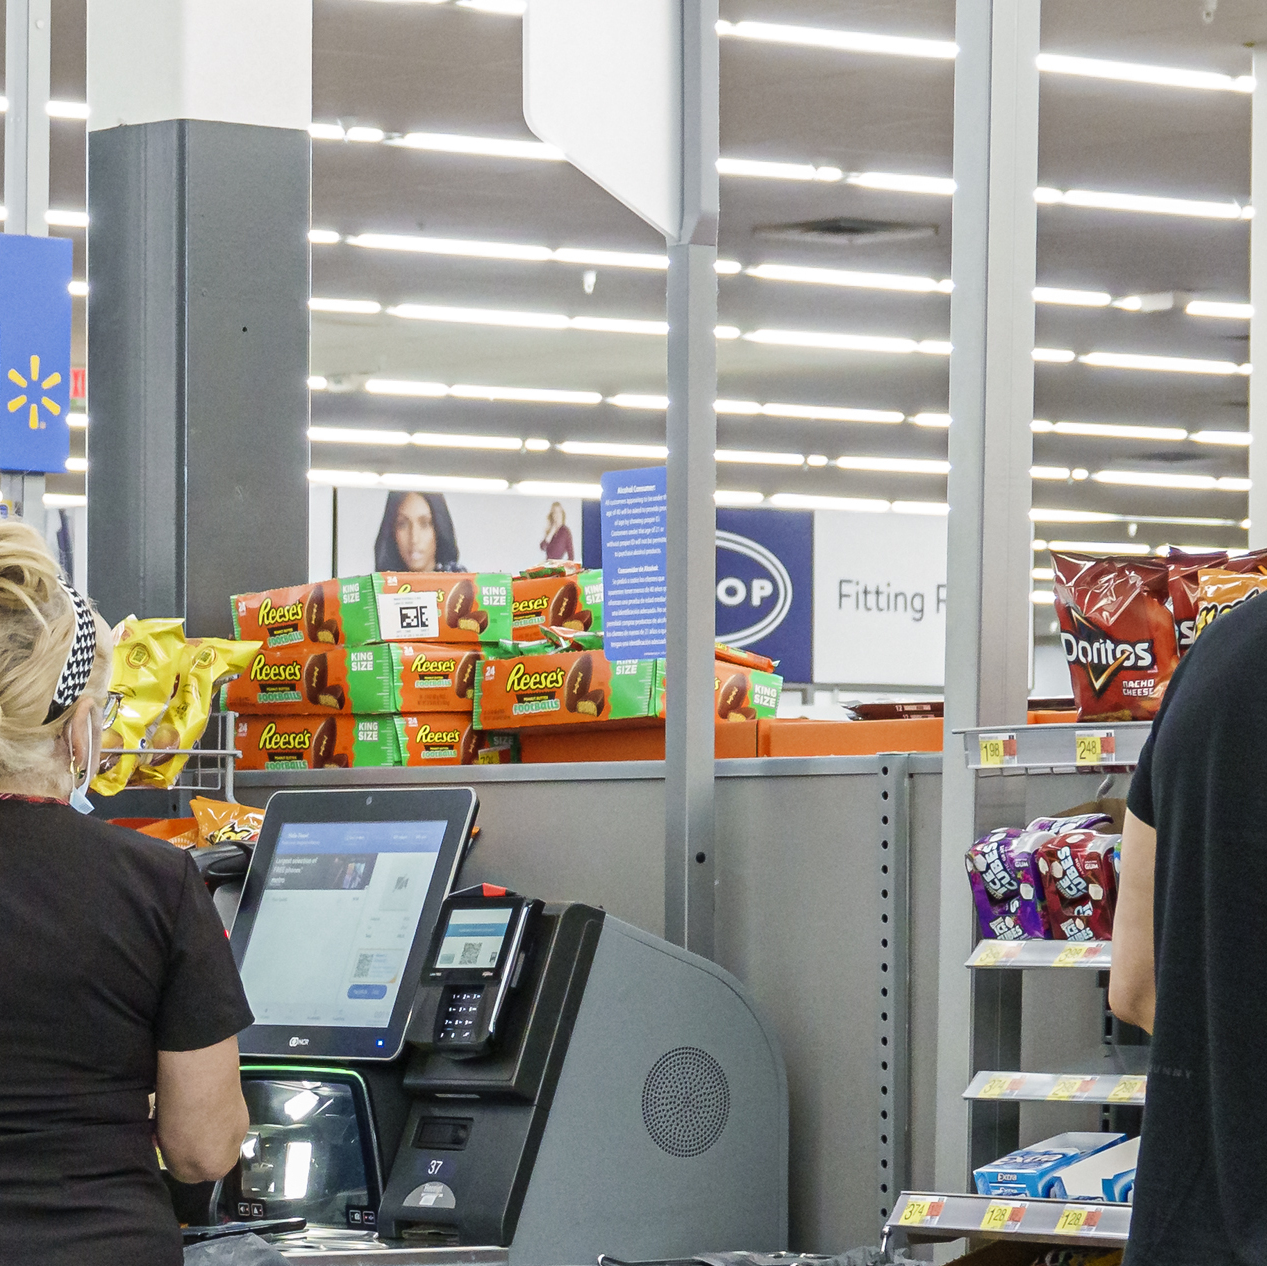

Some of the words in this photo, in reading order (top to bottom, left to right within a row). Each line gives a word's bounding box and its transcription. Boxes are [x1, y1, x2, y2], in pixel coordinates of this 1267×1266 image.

[342, 583, 360, 594] KING
[481, 586, 507, 596] KING
[716, 577, 774, 607] OP
[343, 593, 360, 604] SIZE
[482, 596, 507, 606] SIZE
[512, 596, 550, 612] eese's
[838, 579, 925, 622] Fitting
[258, 597, 304, 626] Reese's
[1060, 632, 1153, 667] Doritos
[351, 652, 373, 662] KING
[411, 653, 456, 673] Reese's
[250, 653, 302, 682] Reese's
[351, 661, 373, 671] SIZE
[616, 664, 637, 675] SIZE
[506, 663, 566, 692] Reese's
[1123, 680, 1155, 688] NACHO
[754, 684, 777, 697] KING
[754, 695, 777, 708] SIZE
[358, 722, 378, 731] KING
[259, 722, 312, 750] Reese's
[358, 731, 379, 741] SIZE
[416, 724, 461, 743] Reese's
[427, 1160, 443, 1174] 37
